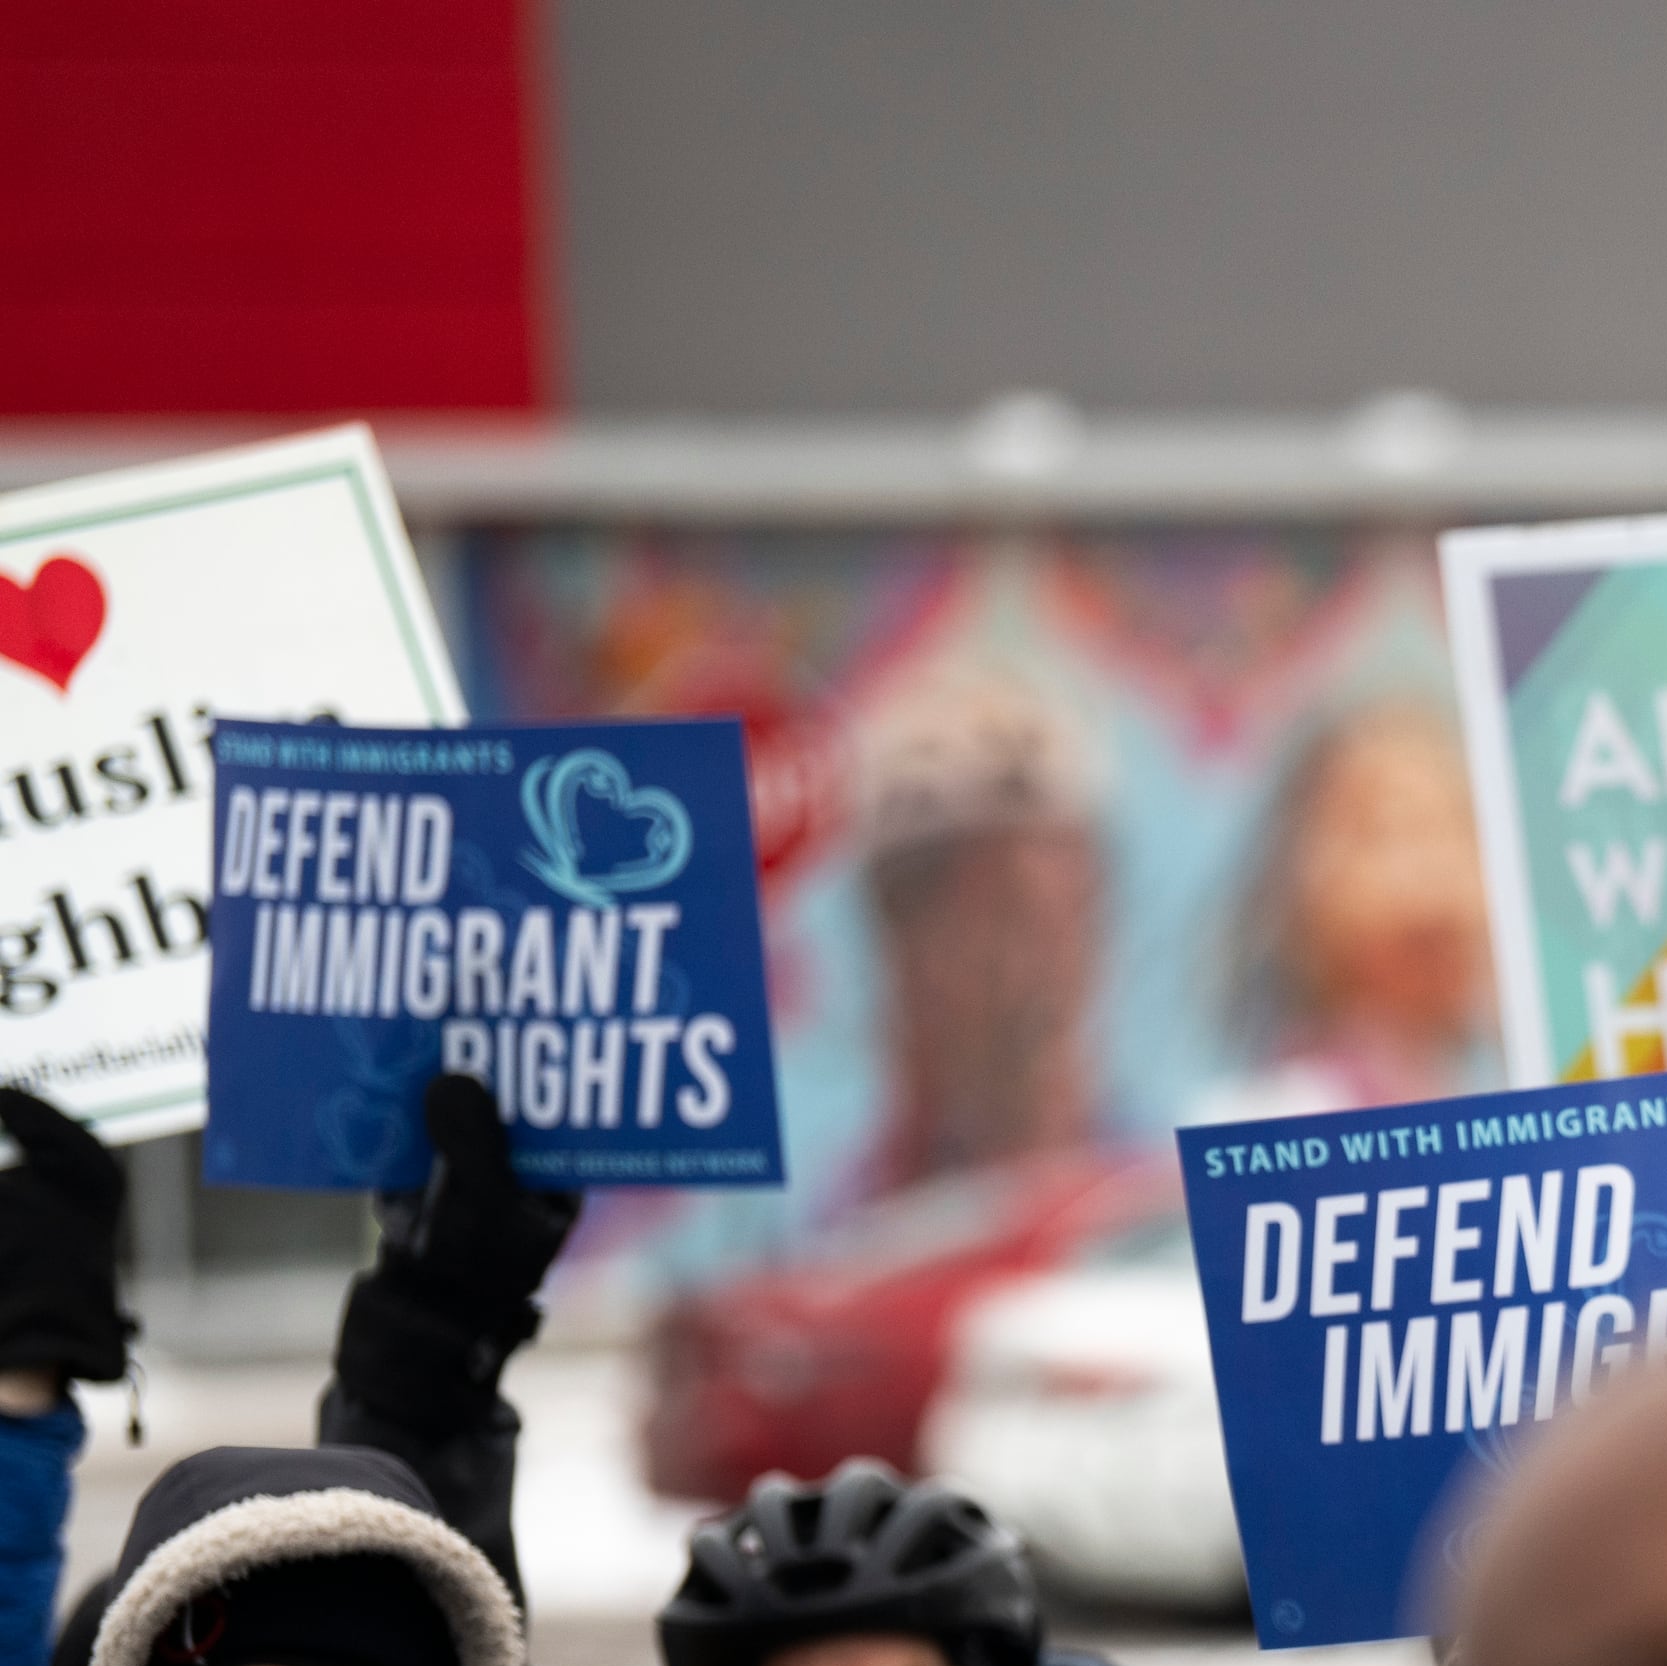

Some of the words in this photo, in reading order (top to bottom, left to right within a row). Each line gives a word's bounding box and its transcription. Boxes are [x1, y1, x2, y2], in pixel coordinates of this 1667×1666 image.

[220, 785, 452, 906] DEFEND
[249, 902, 680, 1020] IMMIGRANT
[441, 1012, 736, 1130] RIGHTS
[1204, 1136, 1330, 1178] STAND
[1340, 1123, 1443, 1164] WITH
[1241, 1163, 1636, 1324] DEFEND
